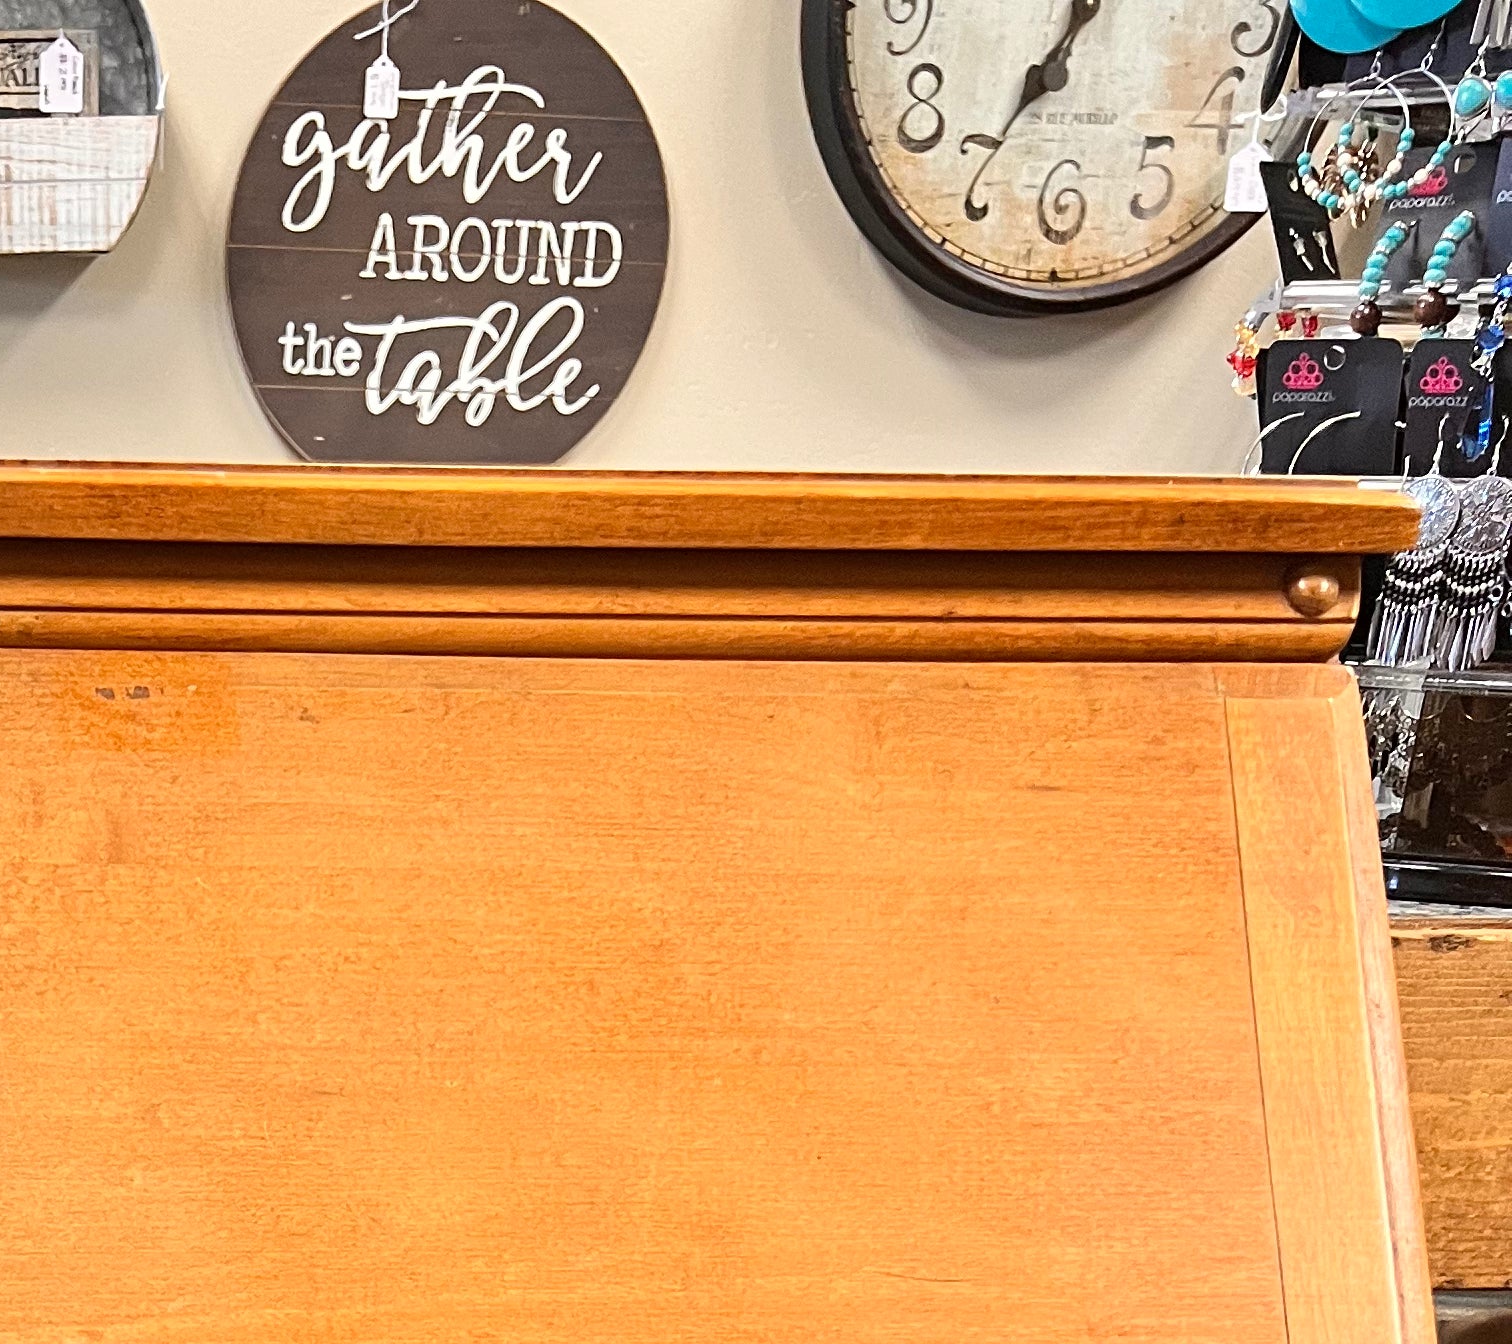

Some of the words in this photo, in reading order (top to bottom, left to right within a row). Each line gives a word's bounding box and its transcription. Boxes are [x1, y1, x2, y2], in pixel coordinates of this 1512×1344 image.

[281, 64, 605, 233] gather
[897, 63, 946, 154] 8
[1183, 66, 1245, 156] 4
[960, 133, 1005, 222] 7
[1037, 158, 1087, 246] 6
[1130, 135, 1176, 221] 5
[1387, 192, 1456, 211] paparazzi
[358, 213, 624, 289] AROUND
[278, 320, 363, 378] the
[344, 296, 601, 428] table
[1272, 389, 1336, 404] paparazzi
[1408, 394, 1469, 409] paparazz
